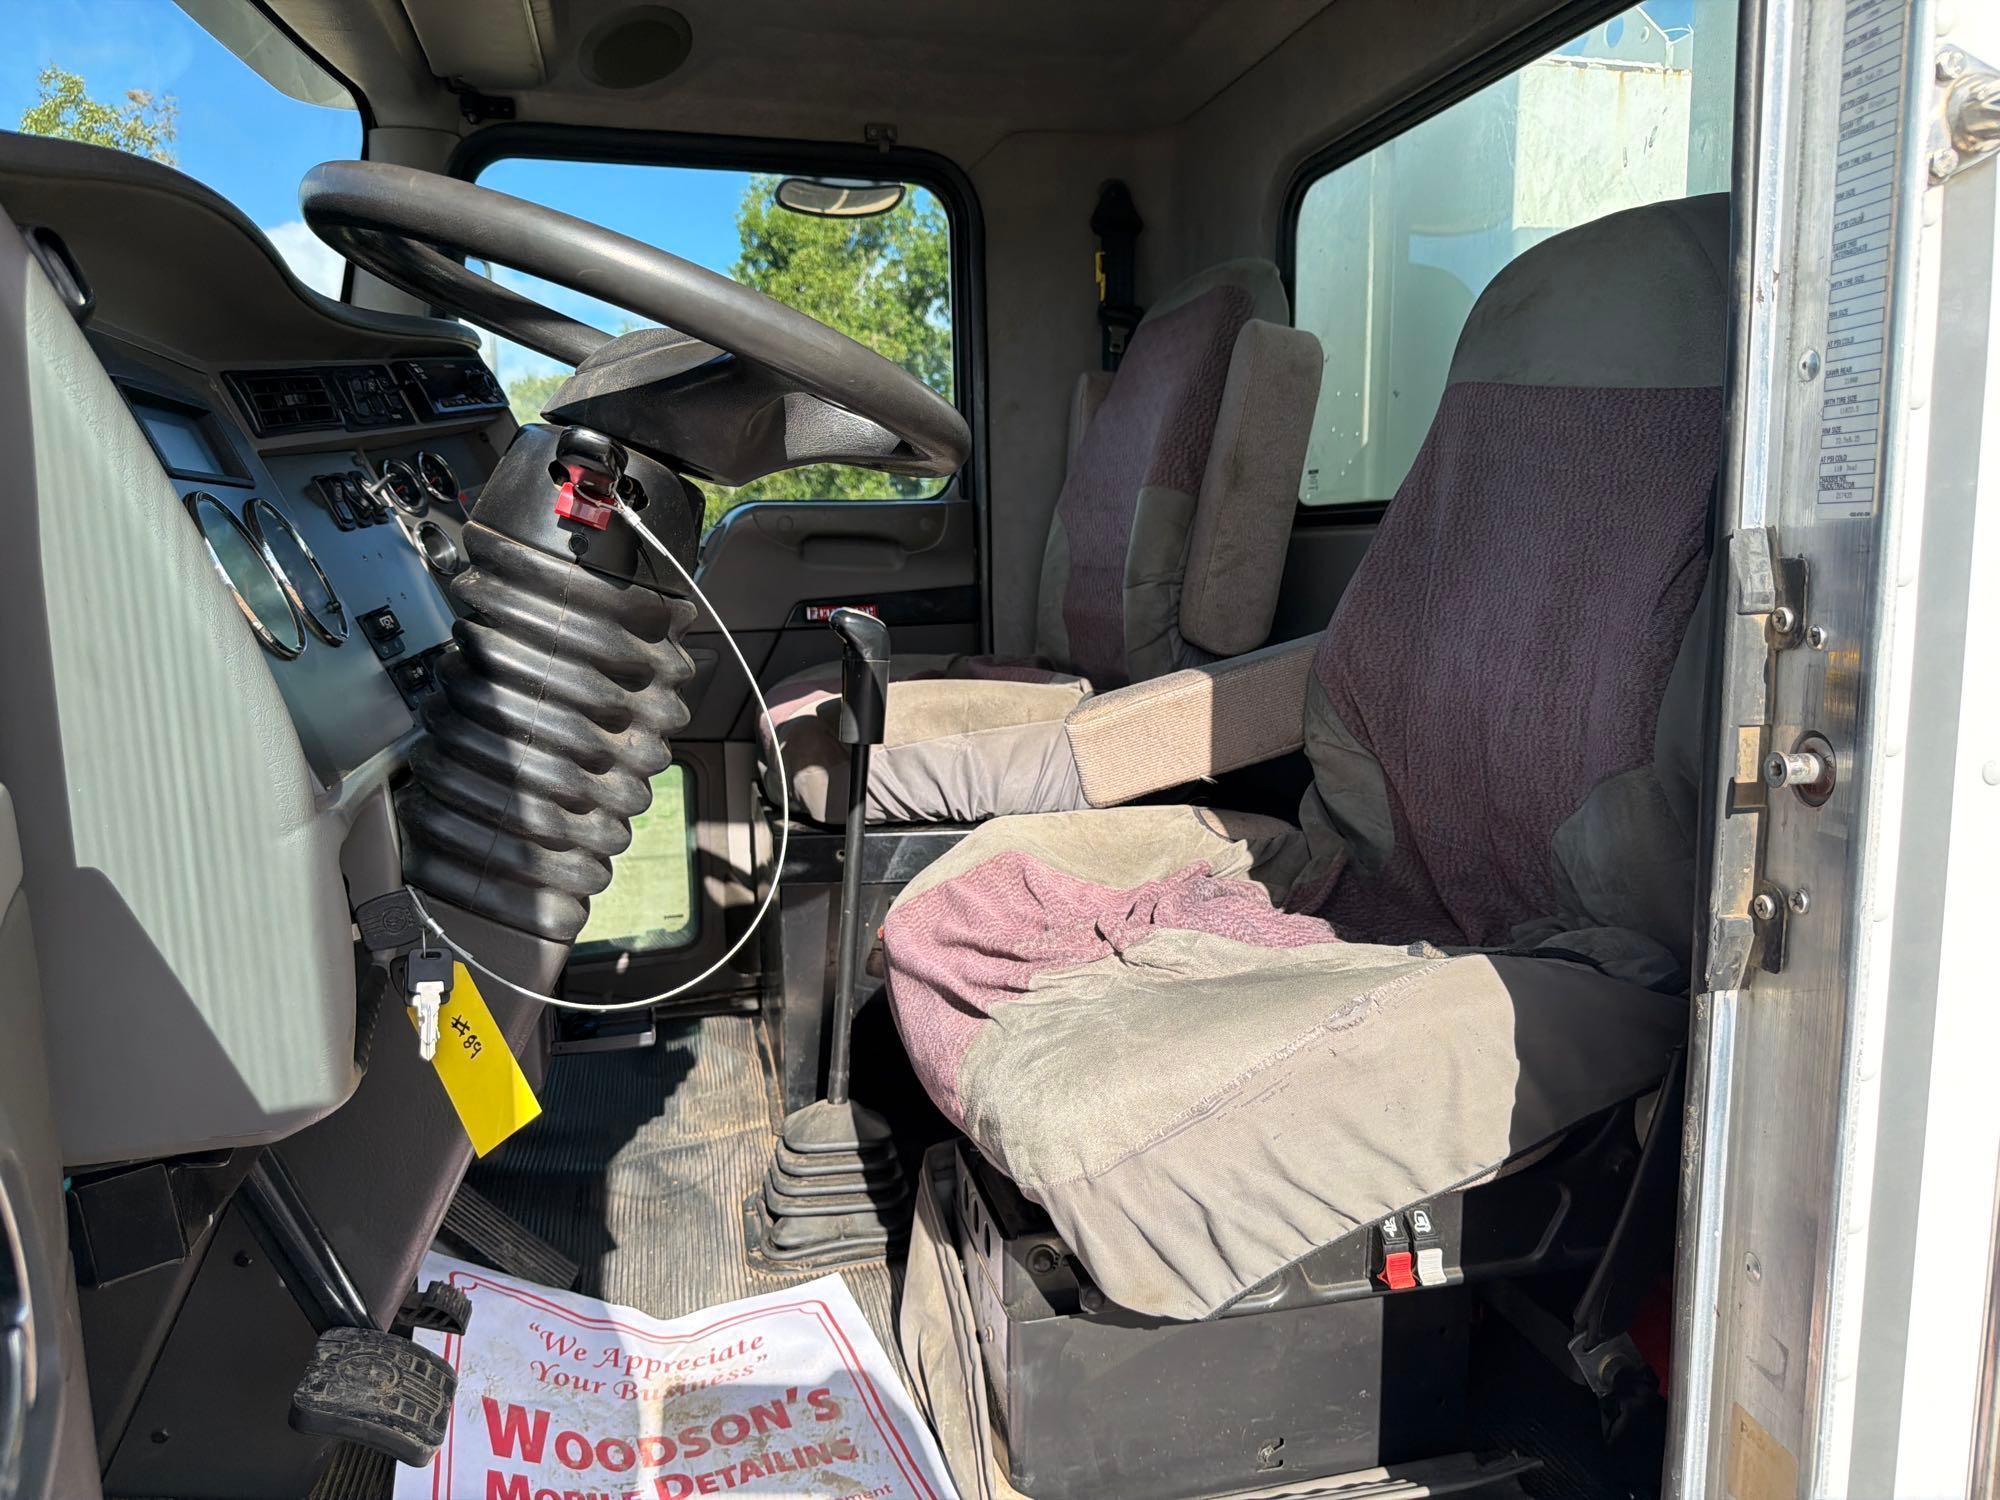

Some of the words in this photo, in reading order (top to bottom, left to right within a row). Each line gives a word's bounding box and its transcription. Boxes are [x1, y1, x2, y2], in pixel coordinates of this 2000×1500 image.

[451, 1014, 483, 1060] #89
[530, 1360, 607, 1394] Your
[593, 1335, 765, 1381] Appreciate
[482, 1386, 842, 1473] WOODSON'S
[653, 1438, 859, 1500] DETAILING
